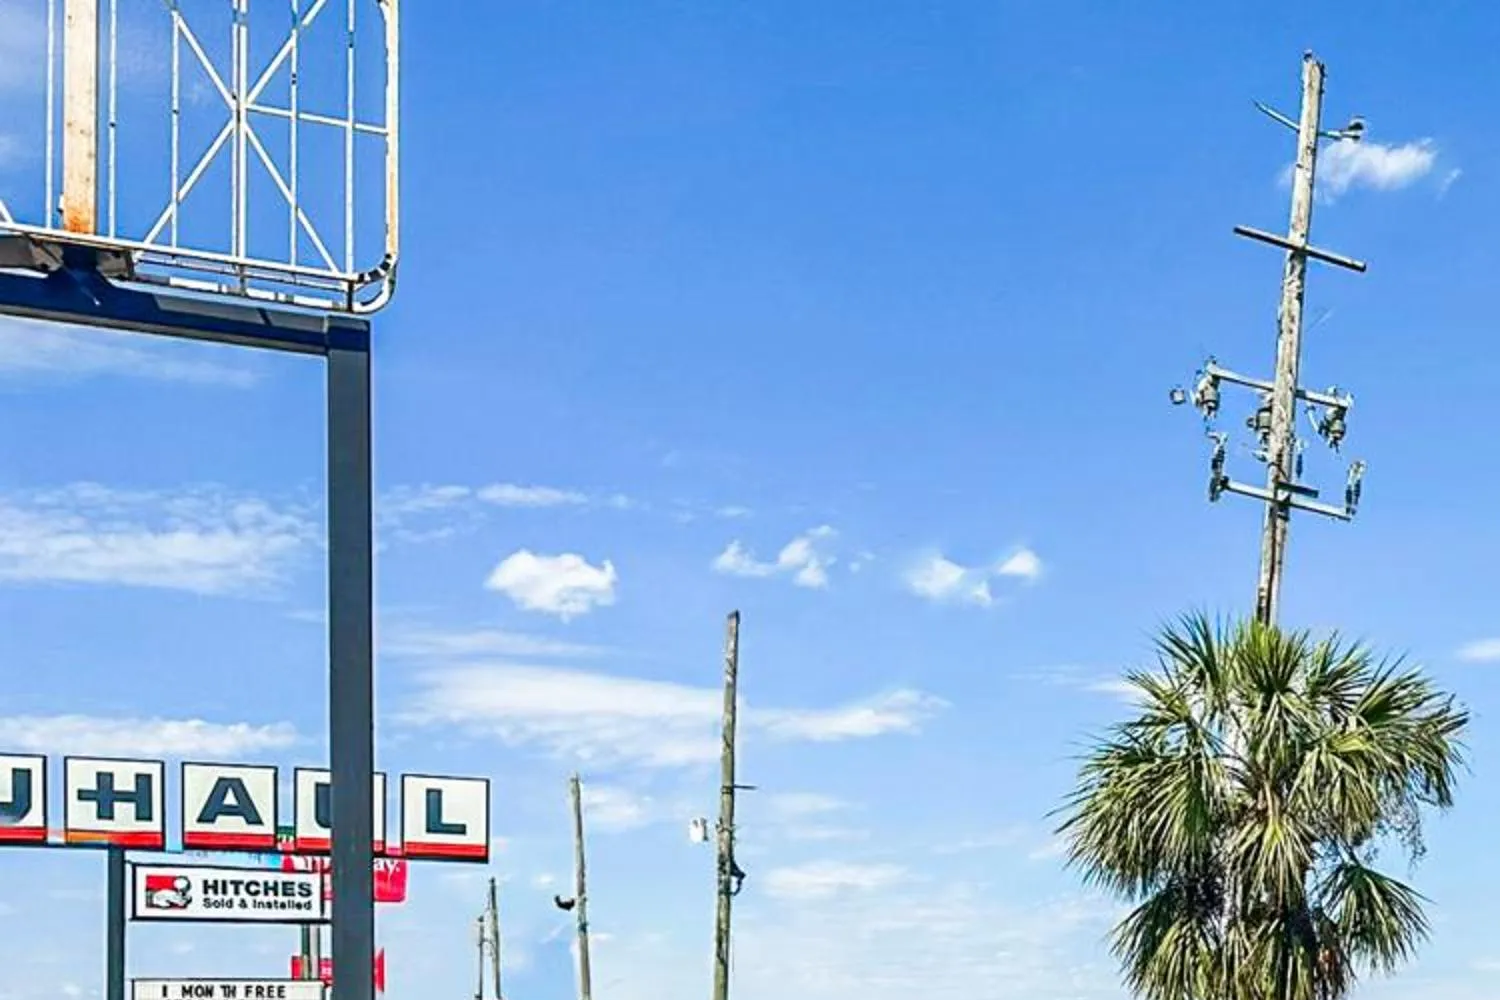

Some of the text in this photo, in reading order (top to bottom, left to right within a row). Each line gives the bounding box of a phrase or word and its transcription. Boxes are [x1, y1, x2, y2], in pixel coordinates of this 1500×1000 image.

[202, 879, 313, 897] HITCHES
[202, 898, 313, 910] Sold & Installed
[244, 985, 287, 999] FREE
